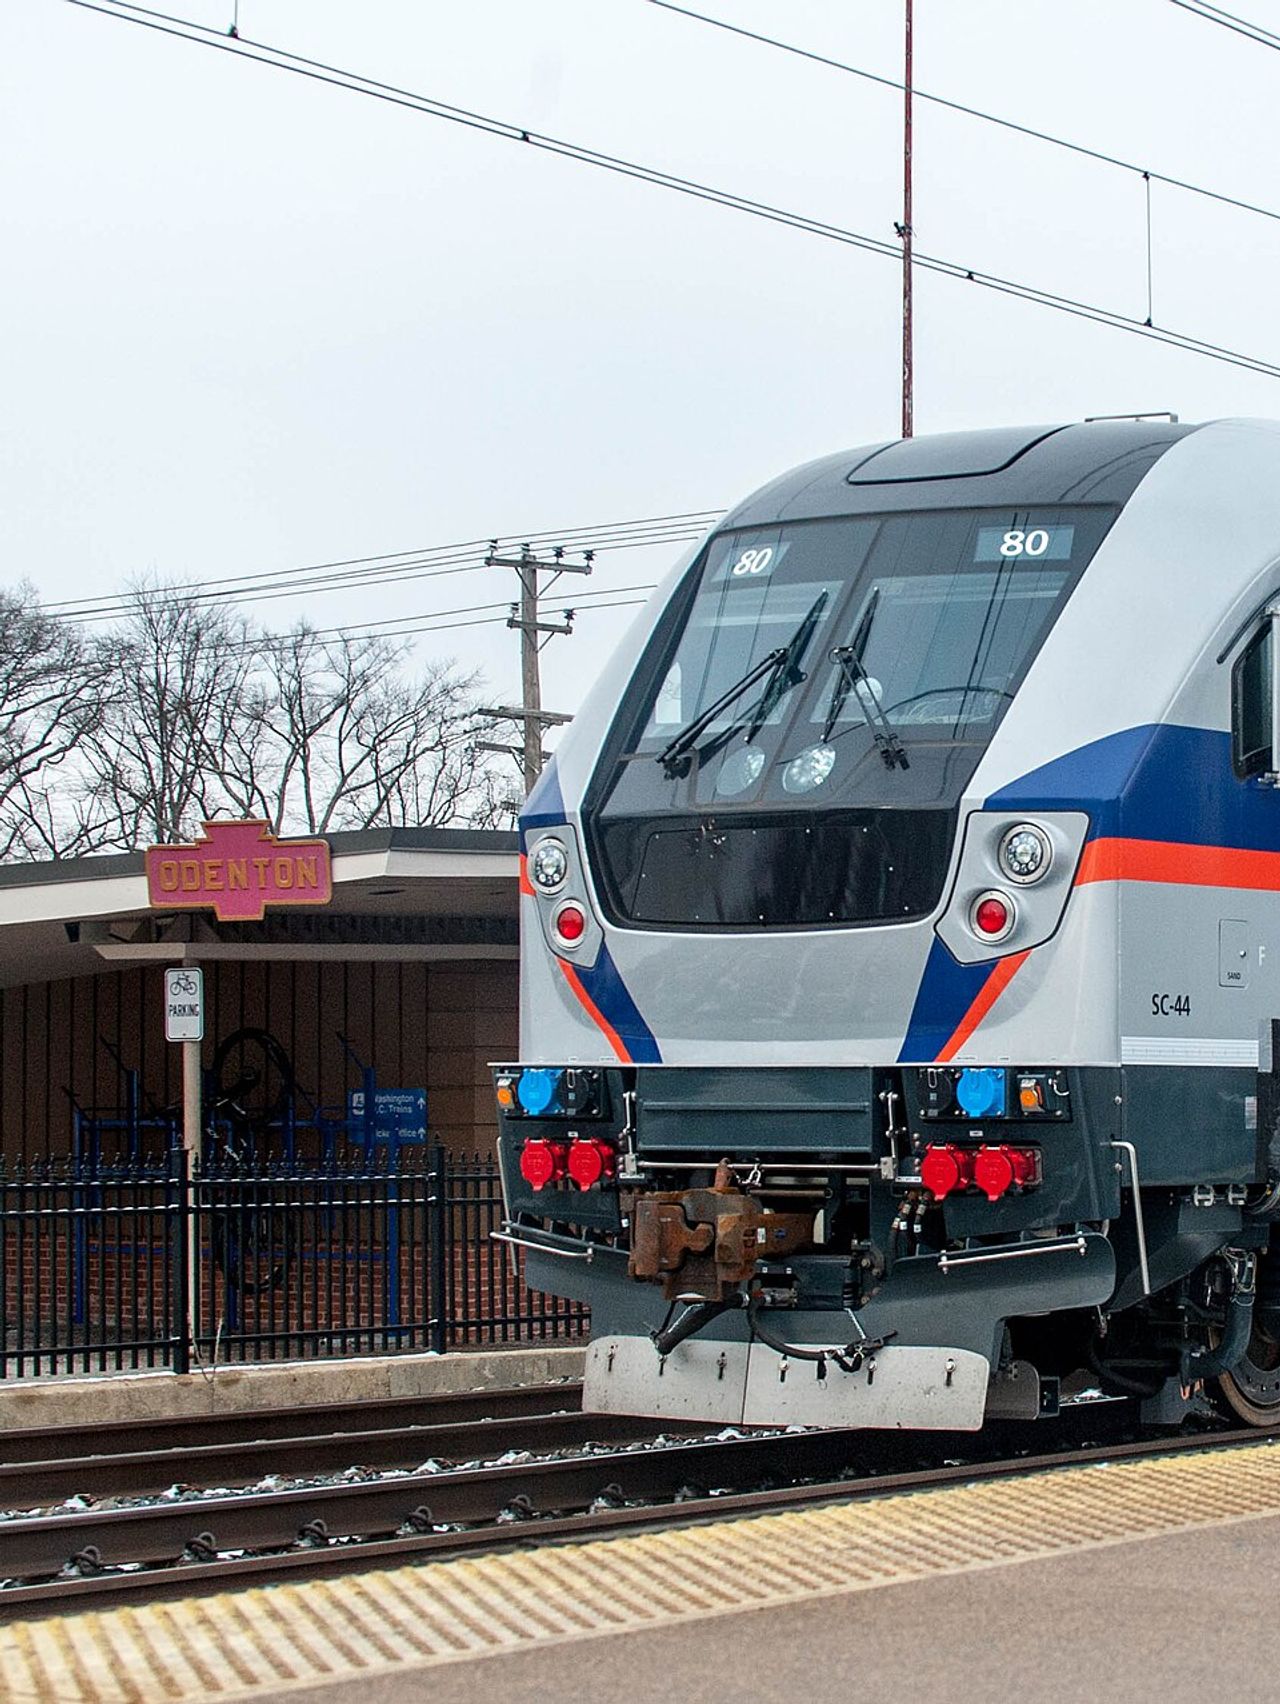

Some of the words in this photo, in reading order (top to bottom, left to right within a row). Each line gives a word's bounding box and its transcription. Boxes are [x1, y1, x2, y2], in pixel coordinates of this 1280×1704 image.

[1000, 530, 1049, 556] 80
[733, 548, 772, 575] 80
[159, 857, 318, 892] ODENTON
[1259, 946, 1266, 966] F
[1227, 972, 1241, 980] SAND
[169, 1003, 199, 1016] PARKING
[1152, 993, 1191, 1016] SC-44
[388, 1104, 412, 1113] Trains
